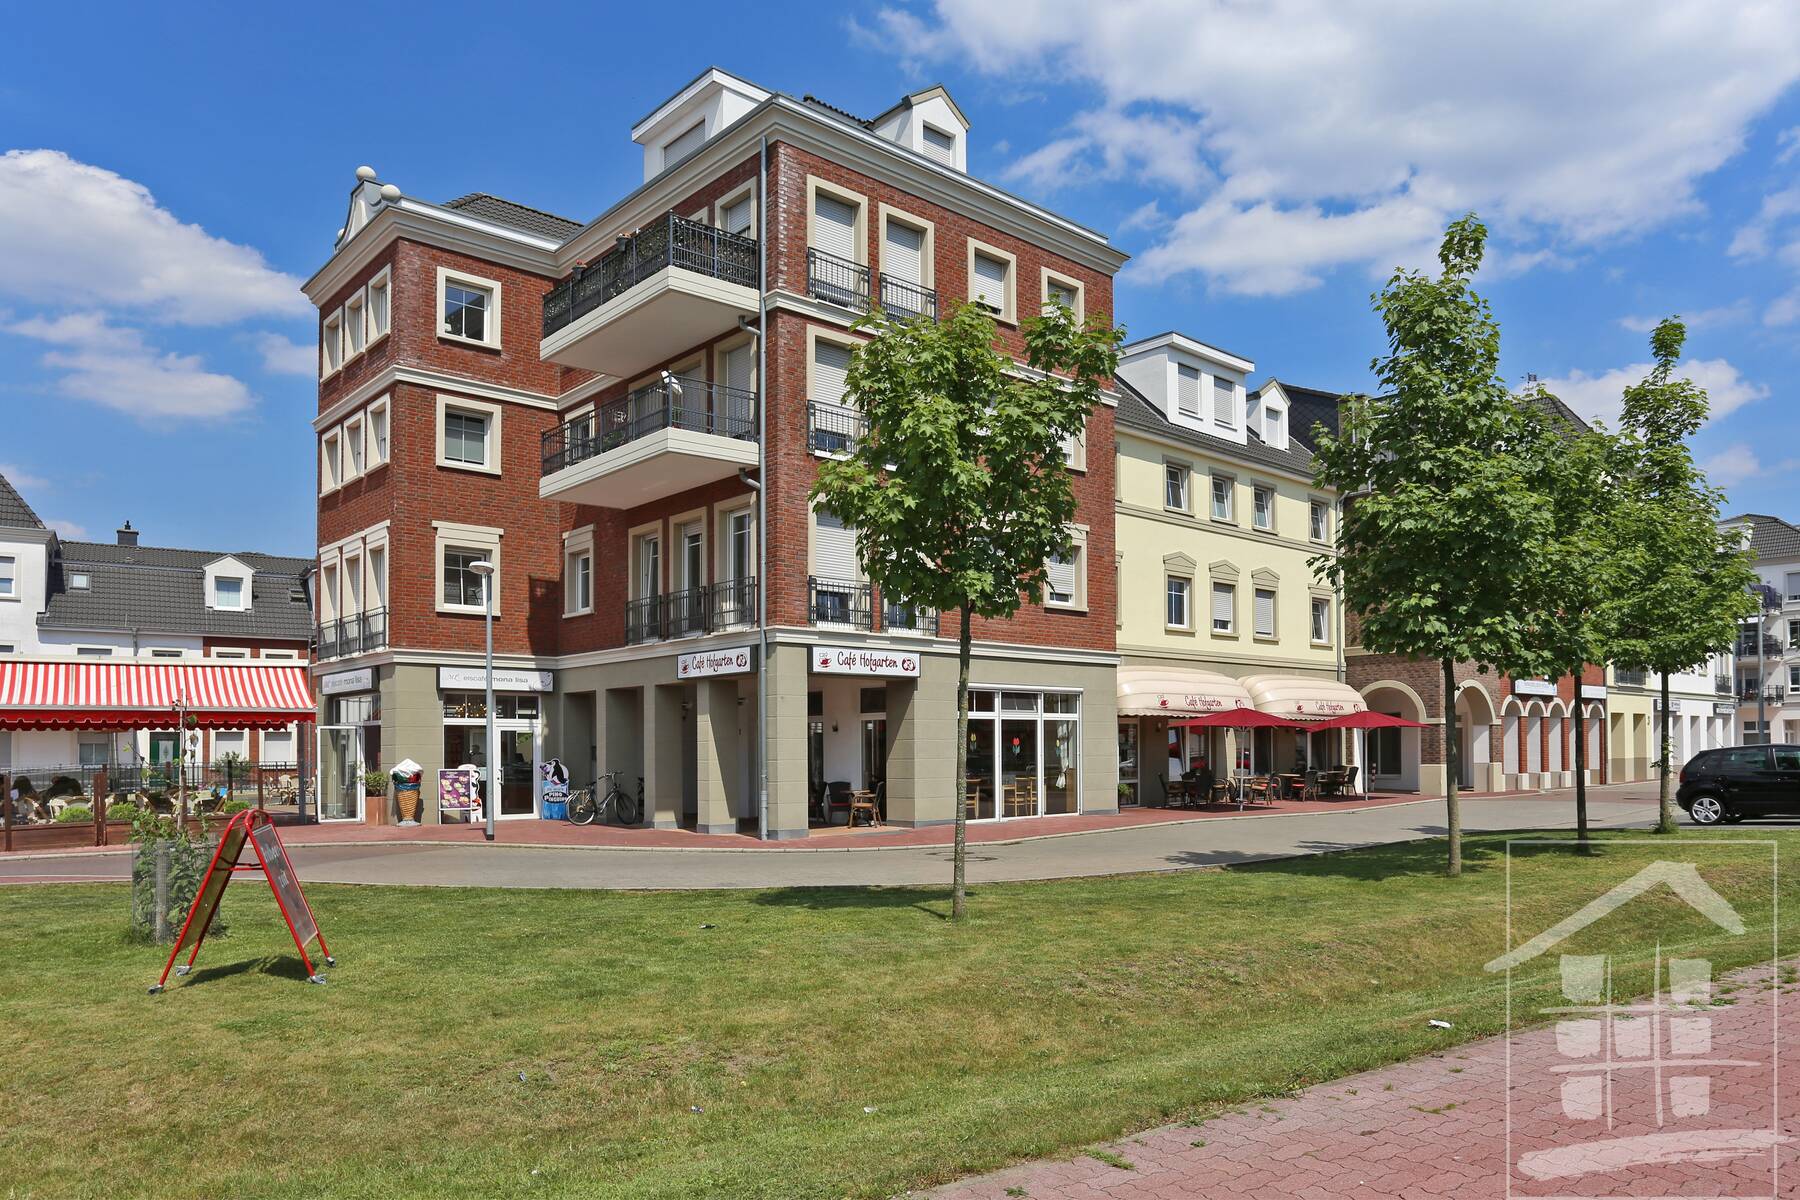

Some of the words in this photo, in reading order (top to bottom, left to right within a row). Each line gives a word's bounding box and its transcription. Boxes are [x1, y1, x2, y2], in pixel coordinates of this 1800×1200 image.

[692, 656, 705, 673] Café
[706, 653, 734, 673] Hofgarten
[837, 651, 857, 670] Café
[860, 653, 898, 672] Hofgarten
